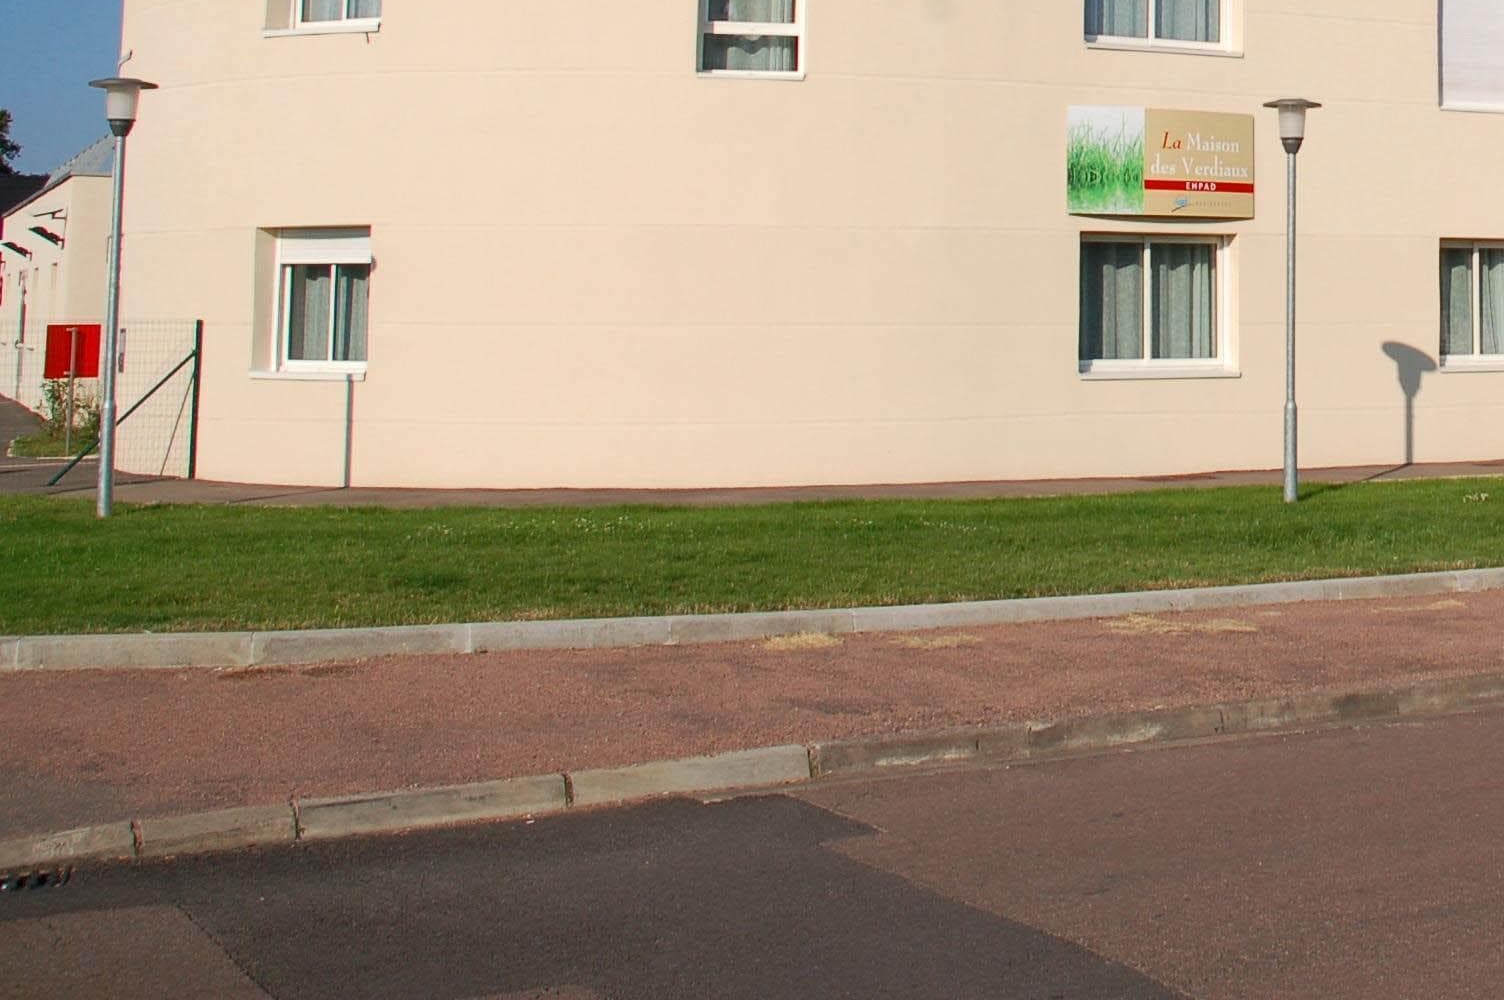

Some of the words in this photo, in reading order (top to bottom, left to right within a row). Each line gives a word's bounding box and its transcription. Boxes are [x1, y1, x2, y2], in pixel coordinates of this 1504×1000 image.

[1162, 131, 1181, 149] La
[1186, 132, 1240, 153] Maison
[1150, 153, 1176, 174] des
[1182, 155, 1249, 177] Verdiaux
[1185, 181, 1217, 192] EHPAD
